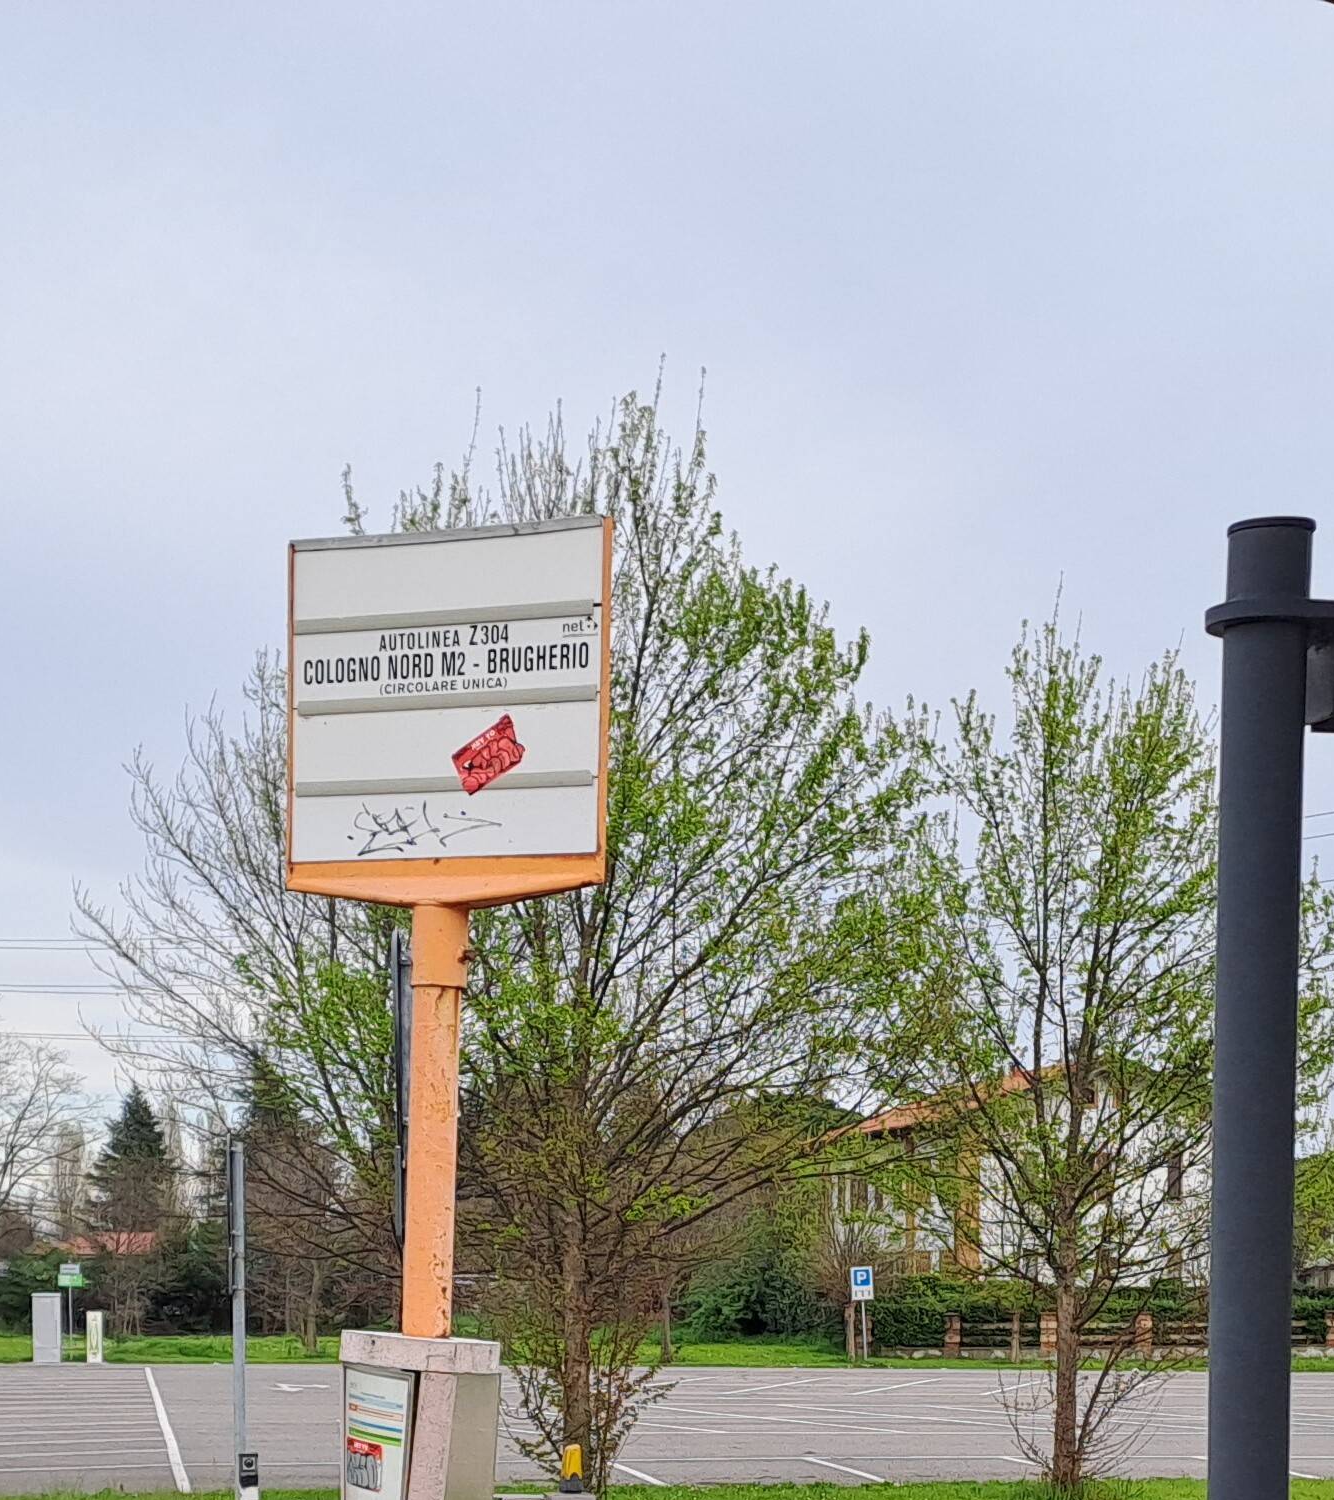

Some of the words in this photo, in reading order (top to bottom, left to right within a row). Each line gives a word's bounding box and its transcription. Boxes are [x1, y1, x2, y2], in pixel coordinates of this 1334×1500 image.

[562, 619, 585, 633] net
[379, 629, 460, 652] AUTOLINEA
[469, 623, 509, 646] Z304
[304, 655, 380, 685] COLOGNO
[388, 653, 434, 680] NORD
[441, 651, 466, 677] M2
[487, 641, 589, 674] BRUGHERIO
[379, 680, 458, 696] (CIRCOLARE
[463, 677, 508, 691] UNICA)
[856, 1271, 867, 1285] P
